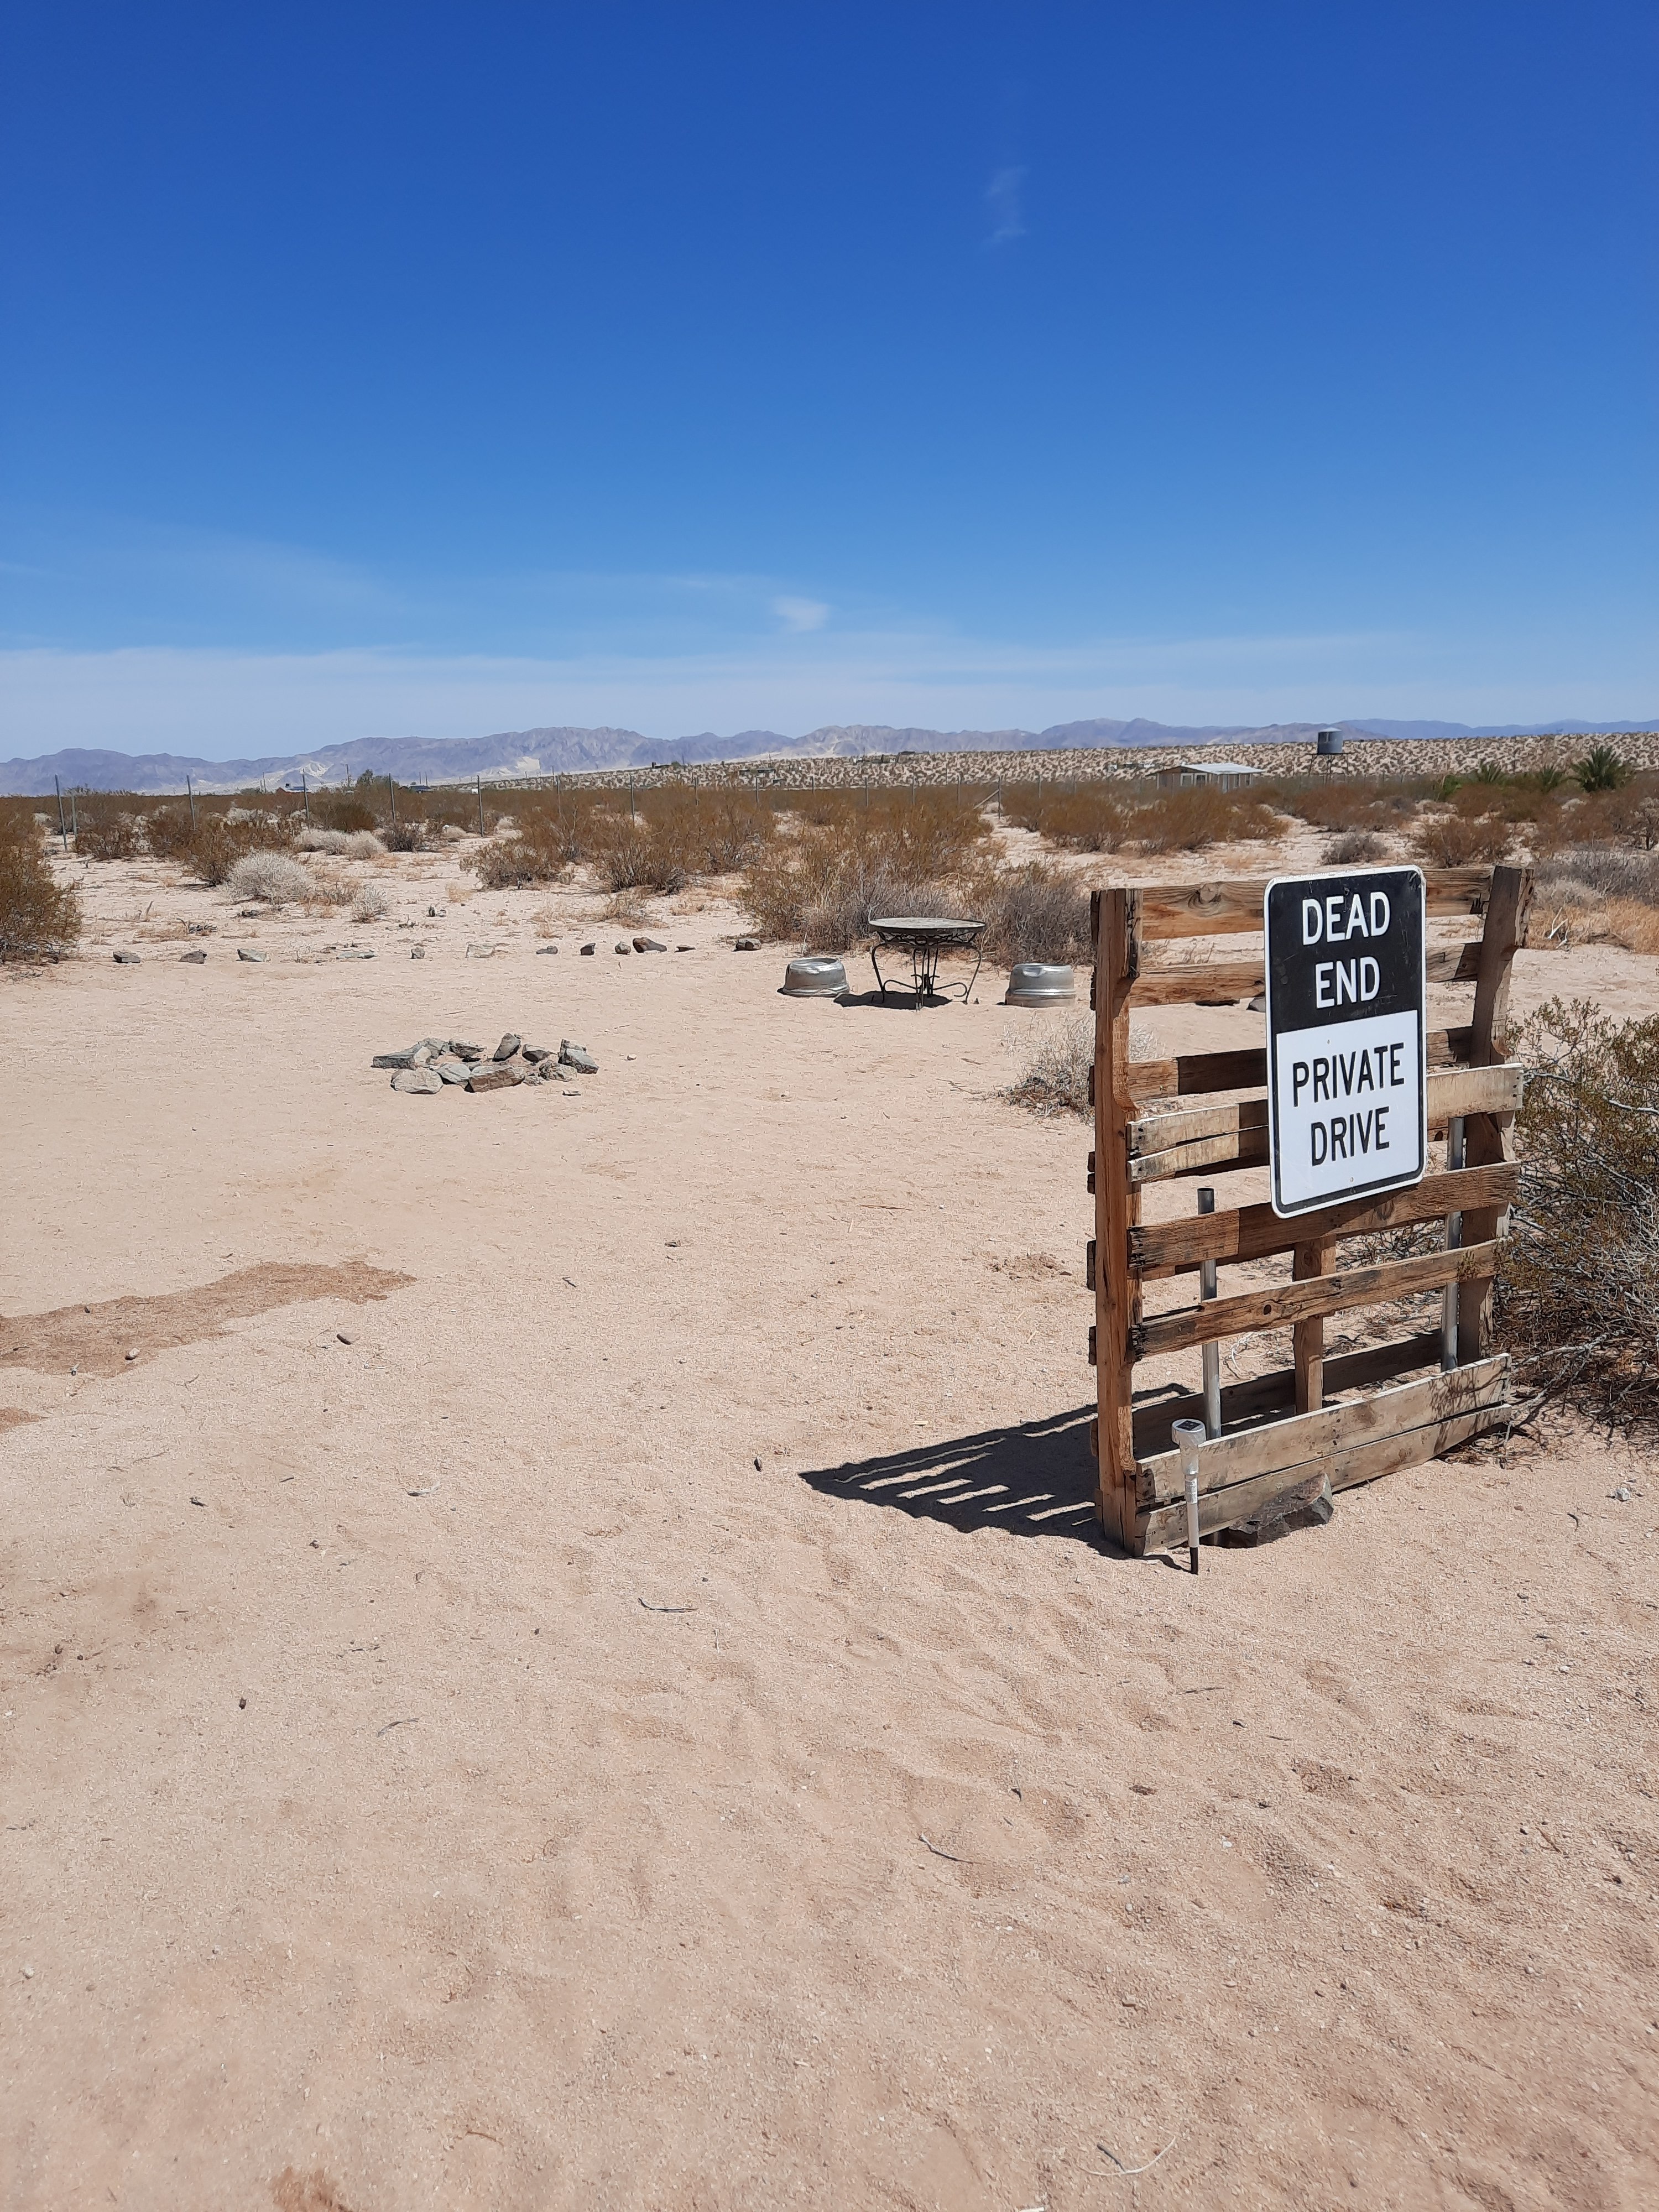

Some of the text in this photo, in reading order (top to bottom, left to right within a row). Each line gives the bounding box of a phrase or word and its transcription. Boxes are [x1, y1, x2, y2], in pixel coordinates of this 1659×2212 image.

[1302, 891, 1390, 946] DEAD
[1316, 956, 1380, 1009] END
[1293, 1042, 1405, 1107] PRIVATE
[1311, 1107, 1390, 1166] DRIVE
